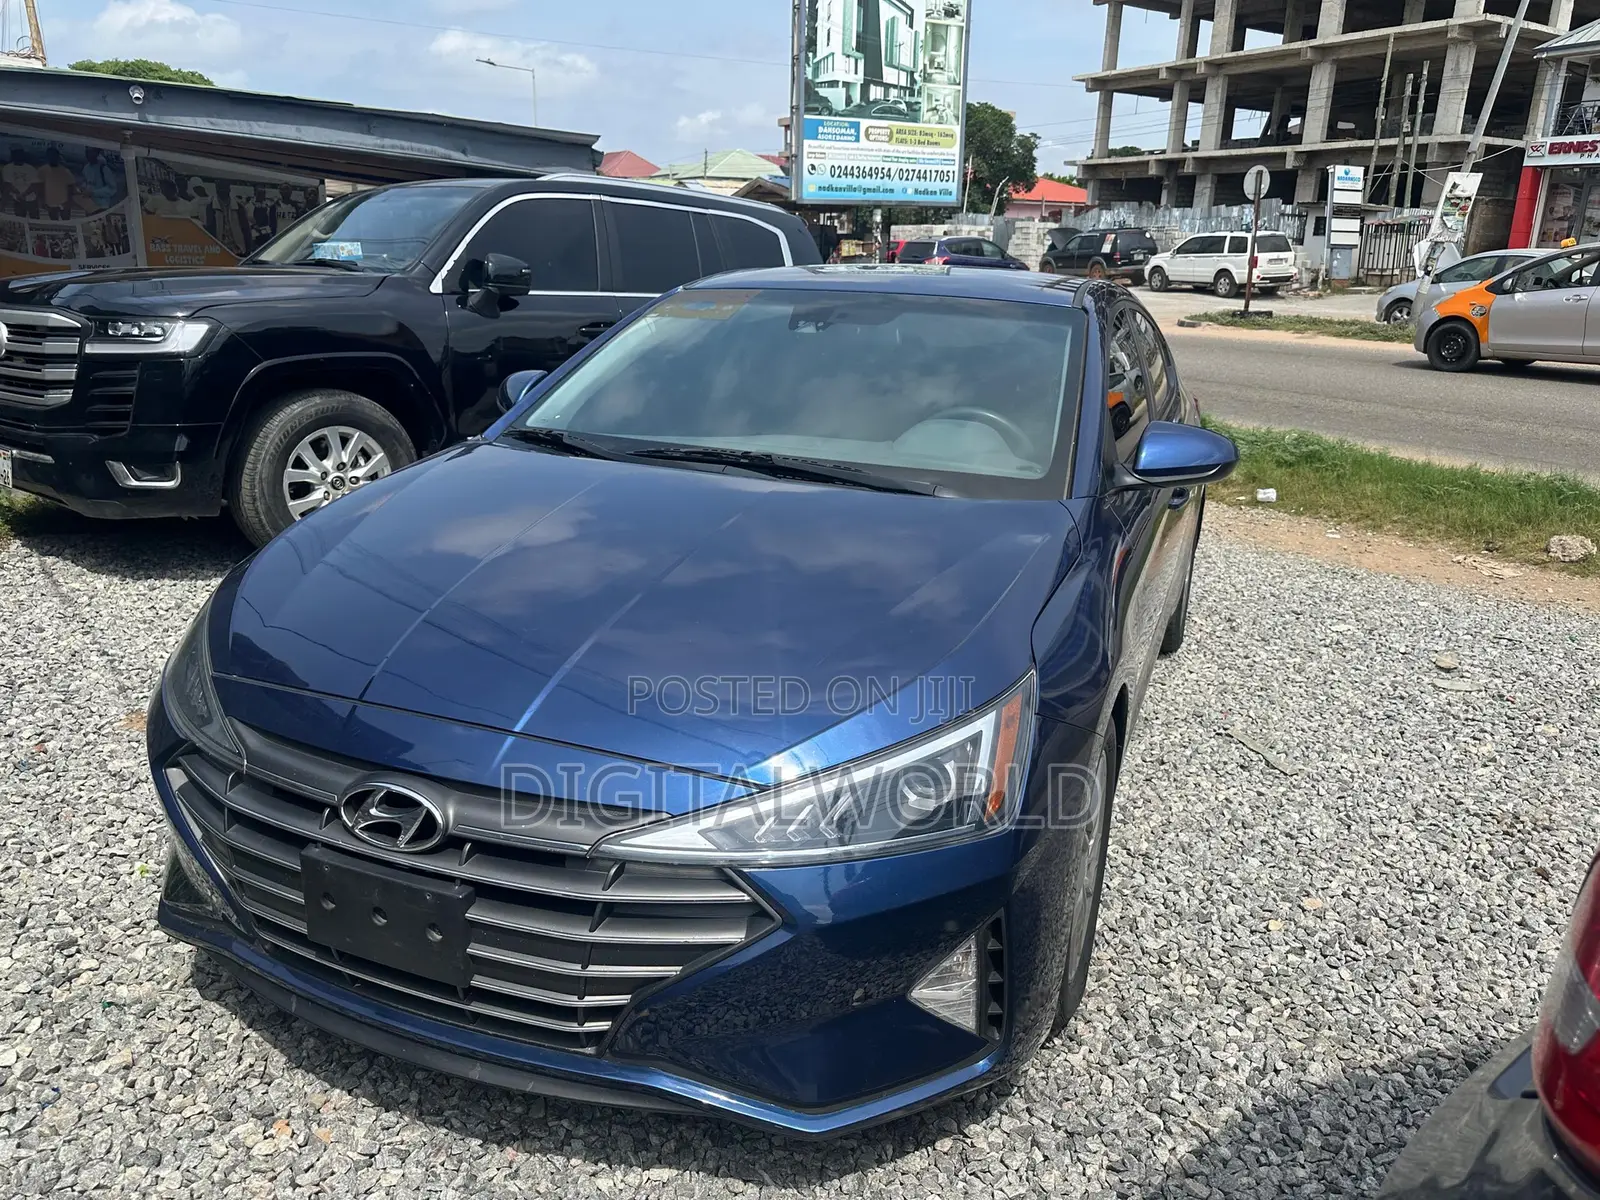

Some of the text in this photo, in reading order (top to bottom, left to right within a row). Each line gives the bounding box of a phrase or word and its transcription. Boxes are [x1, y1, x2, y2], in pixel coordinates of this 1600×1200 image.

[829, 164, 956, 183] 0244364954/0274417051
[173, 245, 202, 255] TRAVEL
[204, 245, 221, 254] AND
[165, 255, 205, 265] LOGISTICS
